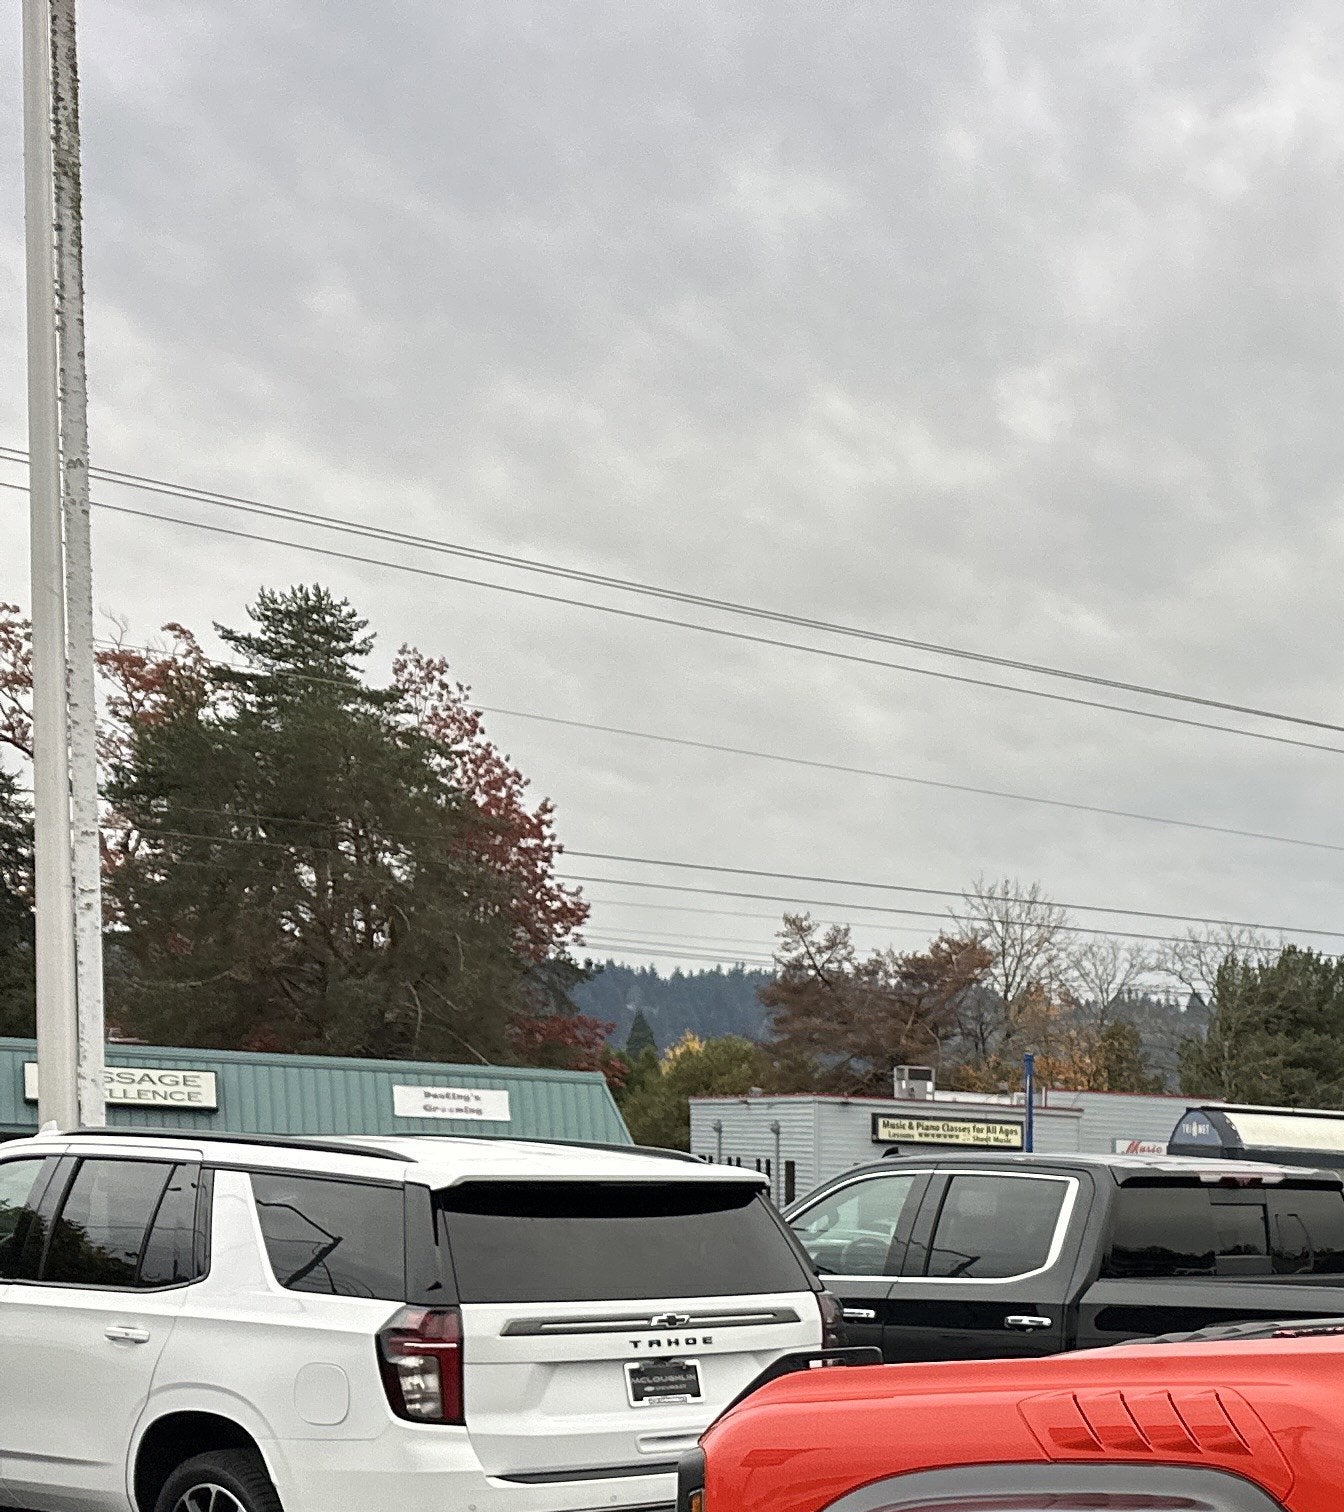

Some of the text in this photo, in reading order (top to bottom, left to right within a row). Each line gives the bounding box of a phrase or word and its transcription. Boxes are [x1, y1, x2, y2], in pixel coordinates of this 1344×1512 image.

[103, 1070, 201, 1088] SSAGE
[106, 1088, 201, 1102] LLENCE
[882, 1119, 1018, 1136] Music & Piano Classes for All Ages
[1125, 1140, 1163, 1155] Music
[629, 1336, 713, 1348] TAHOE
